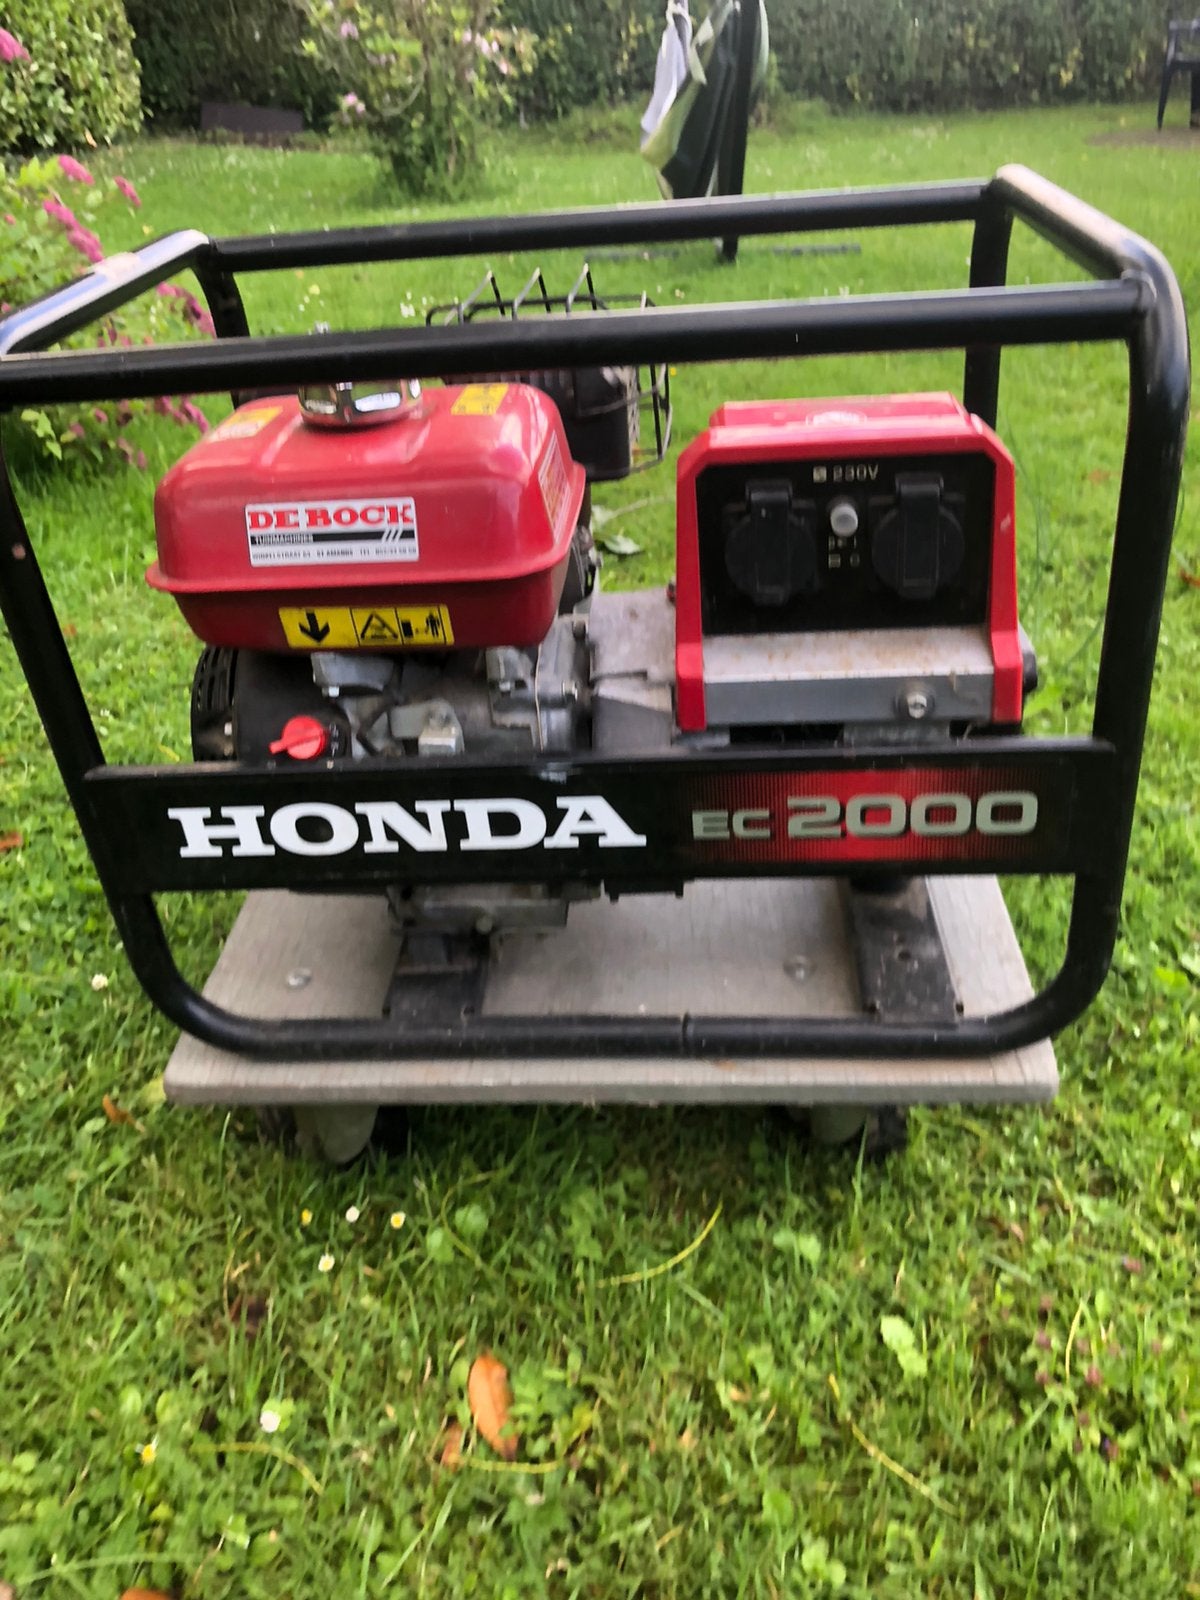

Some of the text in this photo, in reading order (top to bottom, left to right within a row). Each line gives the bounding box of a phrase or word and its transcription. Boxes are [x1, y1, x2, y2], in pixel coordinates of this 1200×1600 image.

[248, 505, 414, 530] DE ROCK
[167, 796, 647, 859] HONDA
[693, 791, 1038, 840] EC 2000
